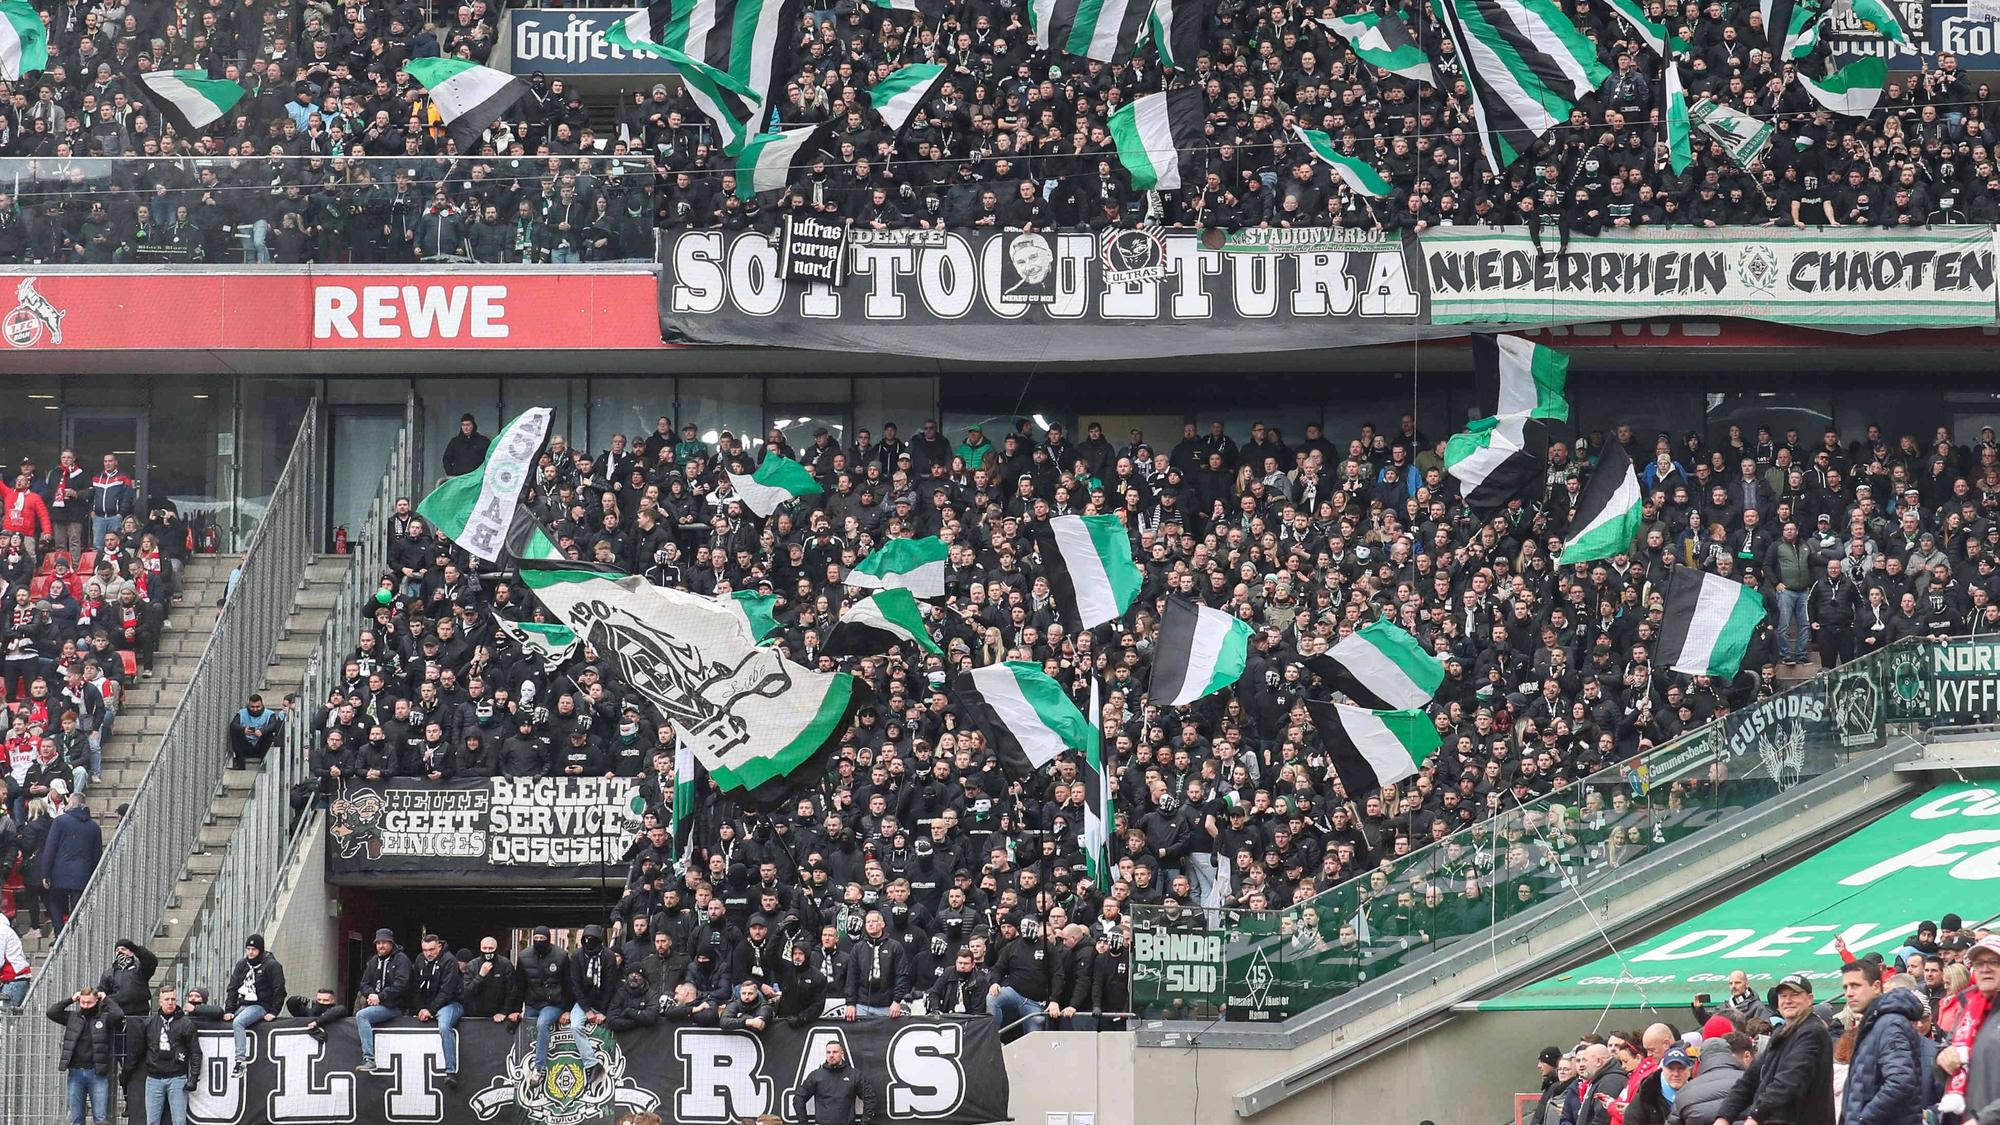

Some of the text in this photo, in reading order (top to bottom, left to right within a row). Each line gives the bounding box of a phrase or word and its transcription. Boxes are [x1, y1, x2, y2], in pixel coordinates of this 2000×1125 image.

[793, 217, 843, 241] ultras
[1245, 226, 1389, 245] STADIONVERBOT
[791, 241, 838, 260] curva
[793, 258, 836, 279] nord
[1112, 266, 1159, 282] ULTRAS
[1428, 249, 1996, 296] NIEDERRHEIN CHAOTEN
[314, 284, 510, 339] REWE
[1730, 695, 1825, 757] CUSTODES
[1649, 739, 1711, 778] Gummersbach
[383, 788, 488, 813] HEUTE
[490, 776, 631, 806] BEGLEIT
[385, 810, 480, 834] GEHT
[489, 805, 622, 836] SERVICE
[380, 830, 486, 857] EINIGES
[1134, 932, 1221, 963] BANDA
[1166, 964, 1217, 993] SUD
[1252, 965, 1267, 984] 15
[554, 1033, 575, 1041] NOR
